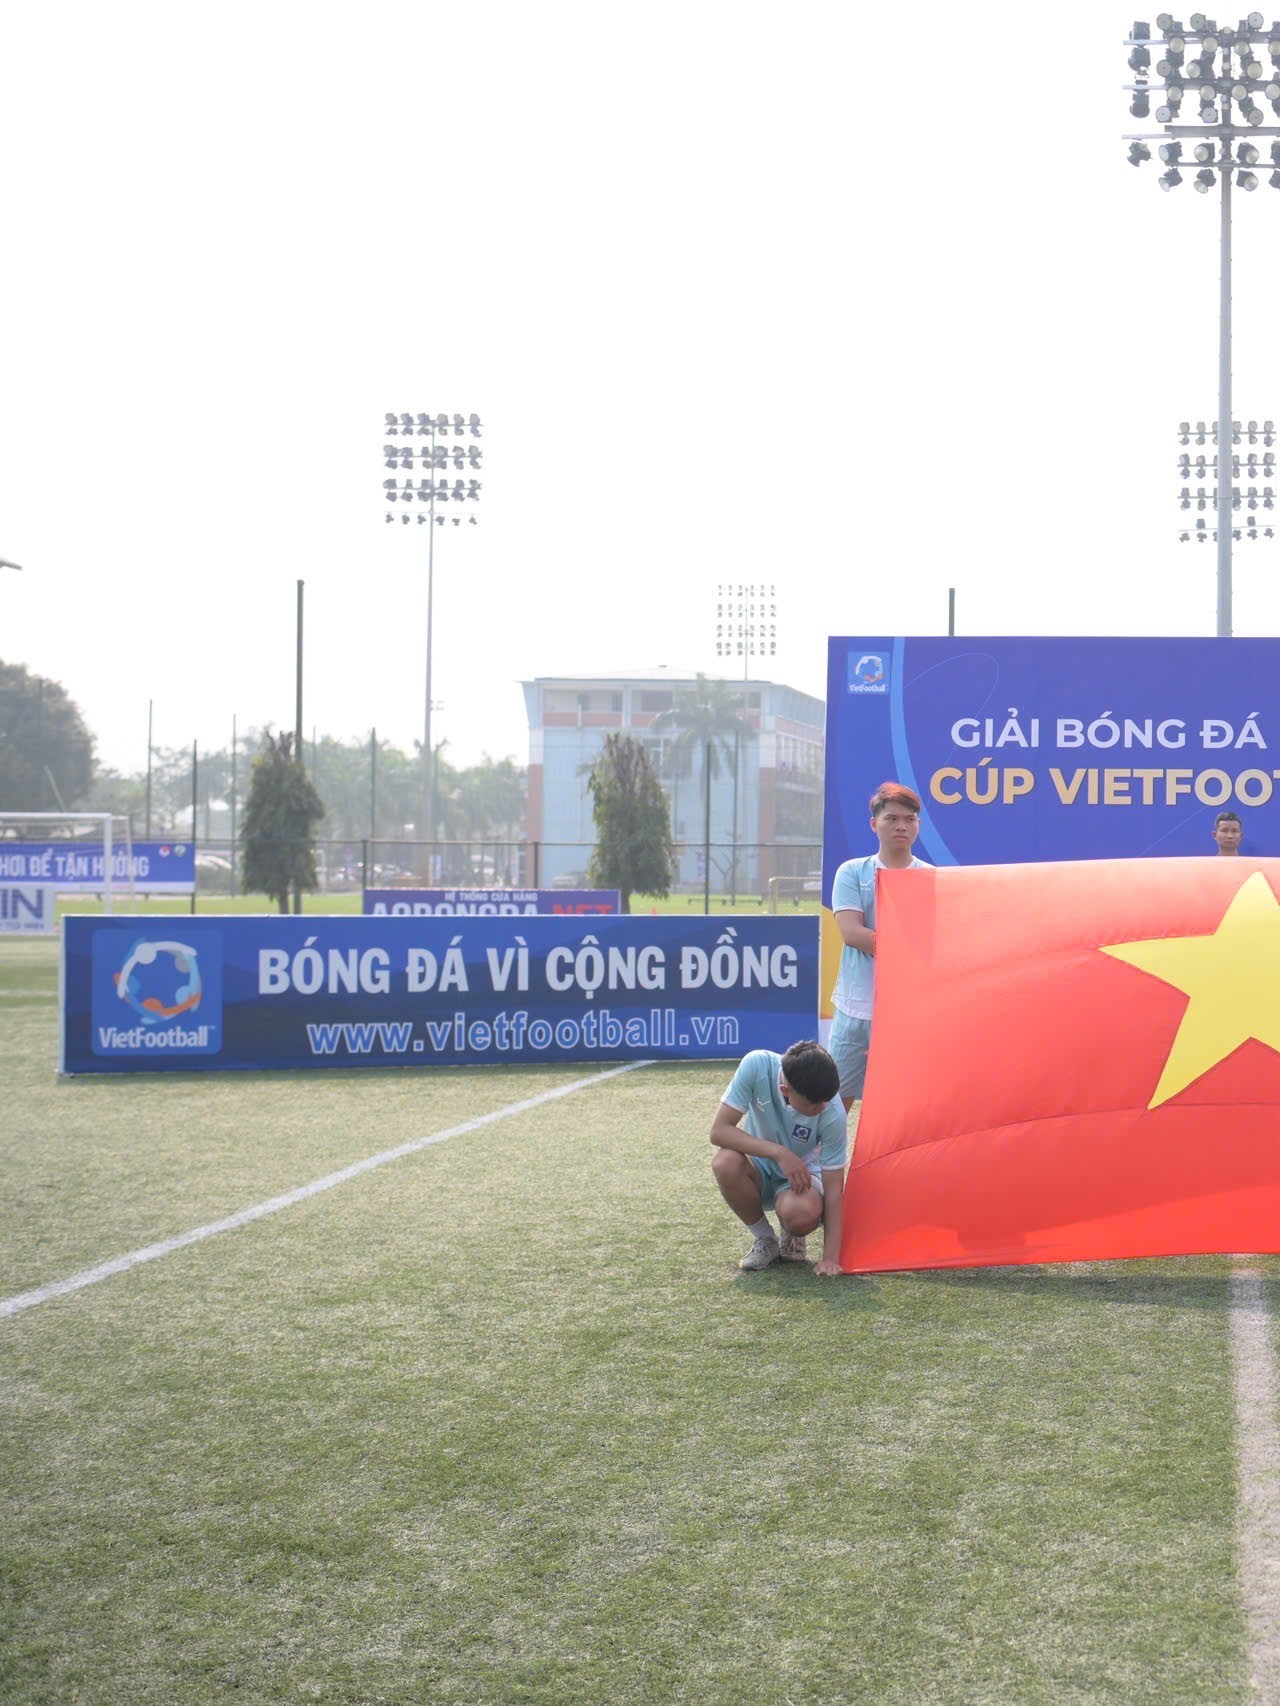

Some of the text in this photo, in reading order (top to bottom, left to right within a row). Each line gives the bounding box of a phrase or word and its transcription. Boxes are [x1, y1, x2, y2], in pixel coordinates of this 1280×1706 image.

[950, 707, 1040, 748] GIẢI
[1056, 710, 1186, 749] BÓNG
[1199, 711, 1268, 749] ĐÁ
[929, 757, 1035, 805] CÚP
[29, 848, 53, 877] ĐỂ
[55, 852, 88, 880] TẬN
[92, 850, 149, 877] HỞNG
[258, 926, 798, 1000] BÓNG ĐÁ VÌ CỘNG ĐỒNG
[98, 1026, 208, 1048] VietFootball
[306, 1008, 740, 1054] www.vietfootball.vn
